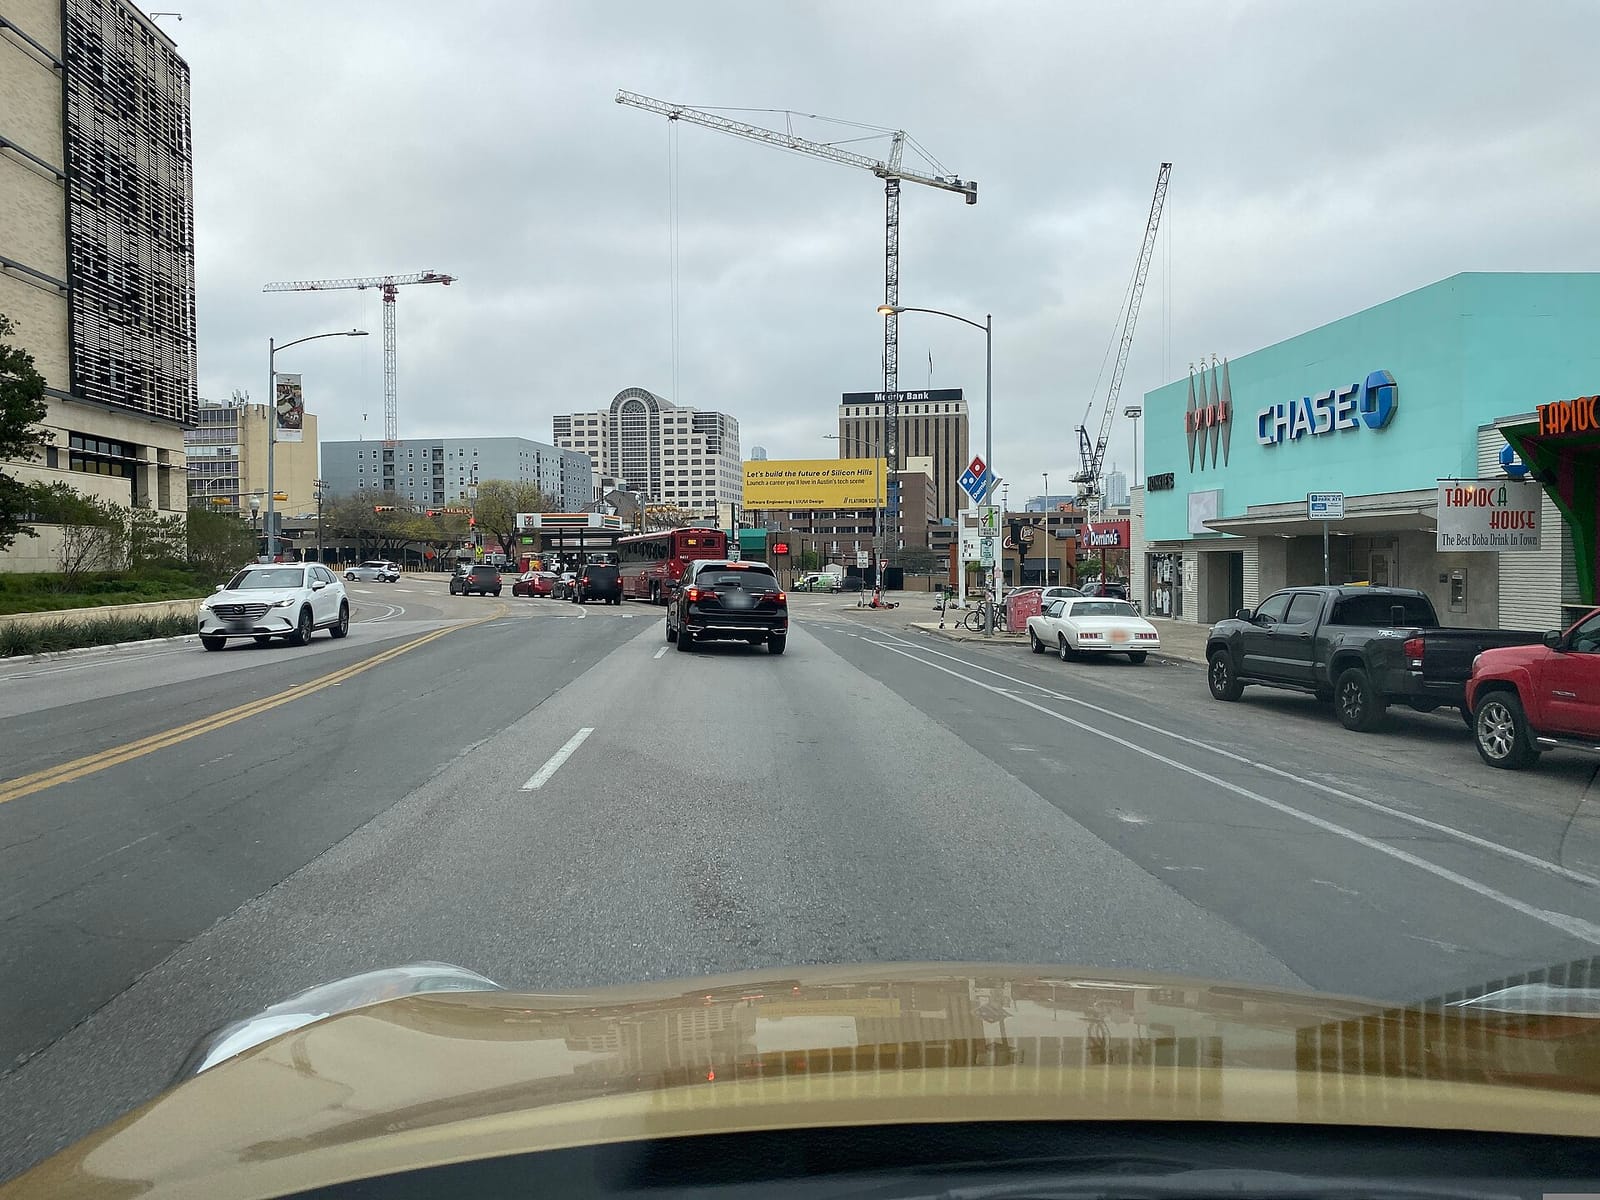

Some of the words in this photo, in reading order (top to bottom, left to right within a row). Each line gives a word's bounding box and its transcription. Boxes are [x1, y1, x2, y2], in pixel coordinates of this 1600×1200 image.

[906, 392, 929, 400] Bank
[1184, 401, 1227, 433] 1904
[1257, 384, 1359, 444] CHASE
[1536, 396, 1600, 435] TAPIOC
[1445, 484, 1508, 507] TAPIOCA
[1489, 511, 1535, 529] HOUSE
[1090, 530, 1119, 546] Domino's
[1442, 533, 1455, 546] The
[1456, 533, 1471, 546] Best
[1472, 533, 1489, 546] Boba
[1490, 533, 1511, 546] Drink
[1511, 533, 1518, 546] In
[1519, 533, 1538, 546] Town
